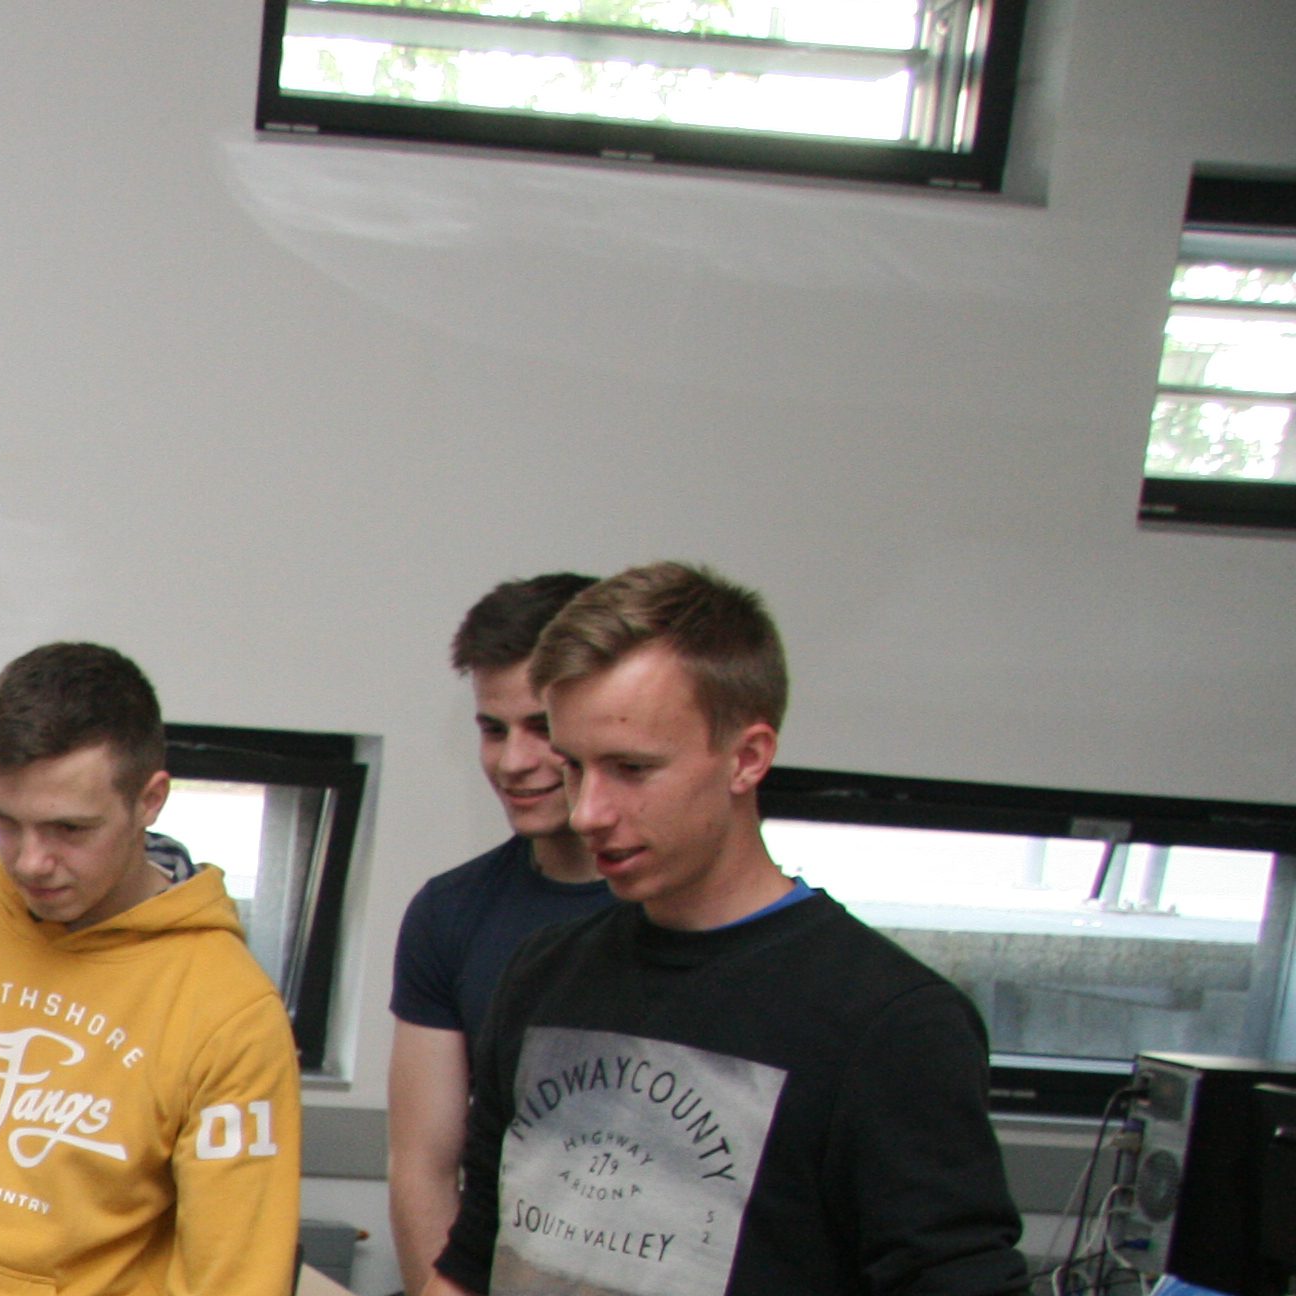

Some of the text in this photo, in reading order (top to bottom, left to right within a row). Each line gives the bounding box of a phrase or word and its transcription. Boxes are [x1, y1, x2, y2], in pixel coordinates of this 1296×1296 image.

[195, 1100, 278, 1161] 01
[563, 1130, 656, 1167] HIGHWAY
[559, 1170, 644, 1202] ARIZONA
